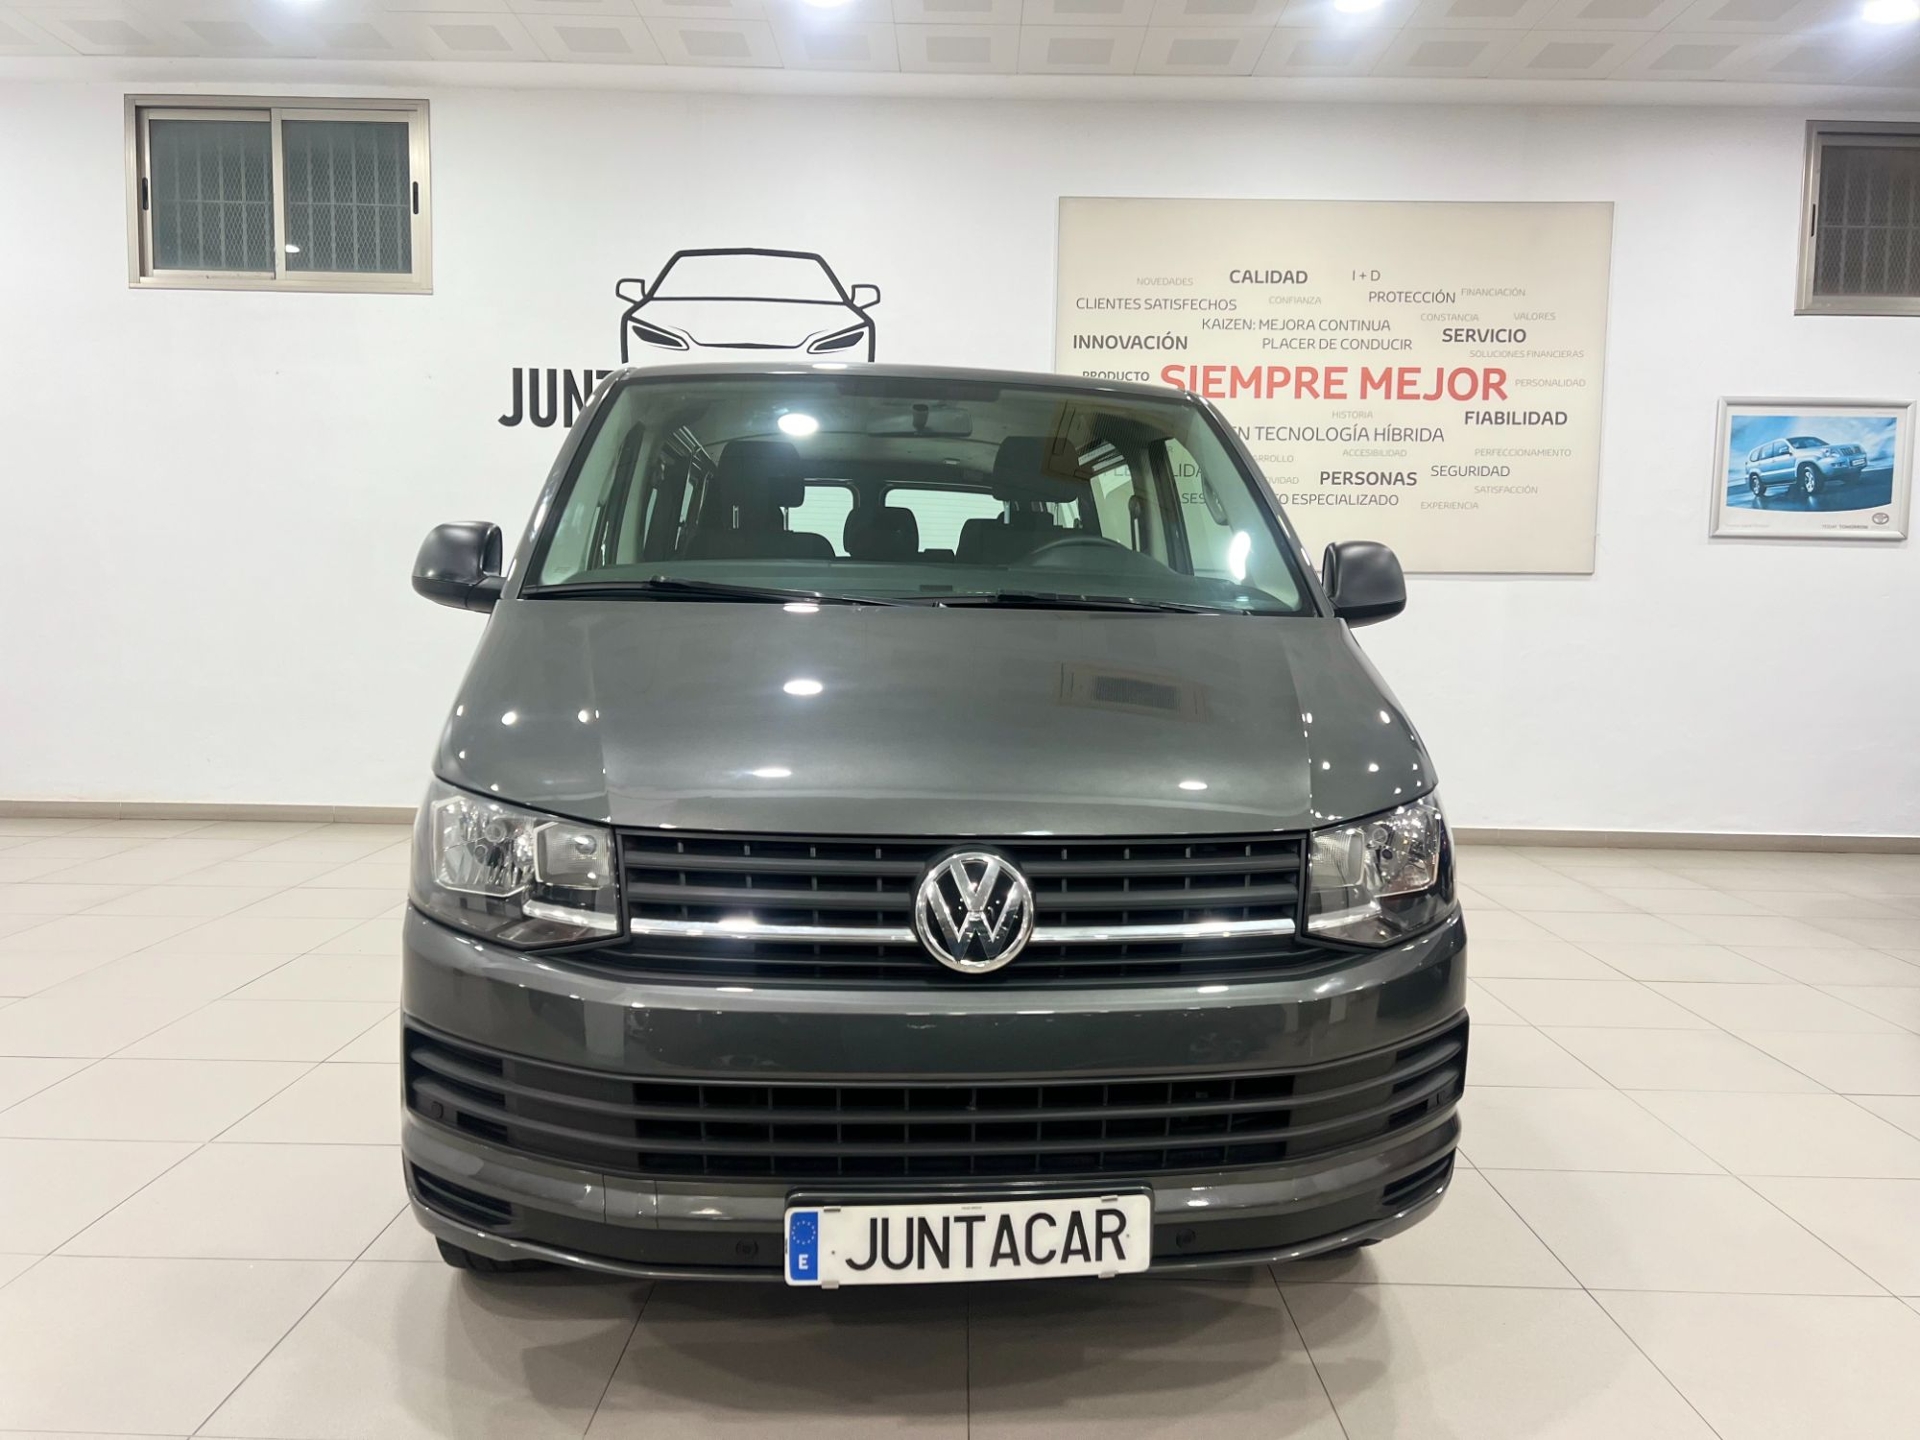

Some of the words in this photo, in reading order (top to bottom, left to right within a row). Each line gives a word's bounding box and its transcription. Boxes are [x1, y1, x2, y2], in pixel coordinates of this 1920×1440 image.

[1136, 277, 1194, 286] NOVEDADES
[1229, 269, 1308, 284] CALIDAD
[1368, 289, 1456, 304] PROTECCIÓN
[1461, 287, 1526, 297] FINANCIACIÓN
[1076, 297, 1141, 311] CLIENTES
[1144, 298, 1238, 311] SATISFECHOS
[1268, 296, 1322, 306] CONFIANZA
[1420, 313, 1479, 322] CONSTANCIA
[1513, 311, 1557, 321] VALORES
[1202, 318, 1256, 331] KAIZEN:
[1258, 318, 1316, 331] MEJORA
[1318, 319, 1391, 332] CONTINUA
[1073, 332, 1188, 350] INNOVACIÓN
[1442, 328, 1527, 343] SERVICIO
[1262, 338, 1316, 350] PLACER
[1318, 338, 1338, 350] DE
[1340, 339, 1413, 350] CONDUCIR
[1469, 350, 1525, 359] SOLUCIONES
[1526, 350, 1585, 359] FINANCIERAS
[1082, 370, 1150, 382] PRODUCTO
[1161, 364, 1348, 400] SIEMPRE
[1359, 366, 1508, 401] MEJOR
[1514, 378, 1587, 388] PERSONALIDAD
[1331, 410, 1374, 419] HISTORIA
[1464, 411, 1568, 426] FIABILIDAD
[1254, 423, 1370, 442] TECNOLOGÍA
[1374, 423, 1445, 442] HÍBRIDA
[1342, 449, 1407, 458] ACCESIBILIDAD
[1474, 447, 1572, 458] PERFECCIONAMIENTO
[1430, 465, 1511, 477] SEGURIDAD
[1319, 470, 1418, 487] PERSONAS
[1474, 484, 1538, 494] SATISFACCIÓN
[1291, 493, 1400, 506] ESPECIALIZADO
[1420, 501, 1480, 510] EXPERIENCIA
[844, 1208, 1127, 1272] JUNTACAR
[798, 1253, 809, 1270] E
